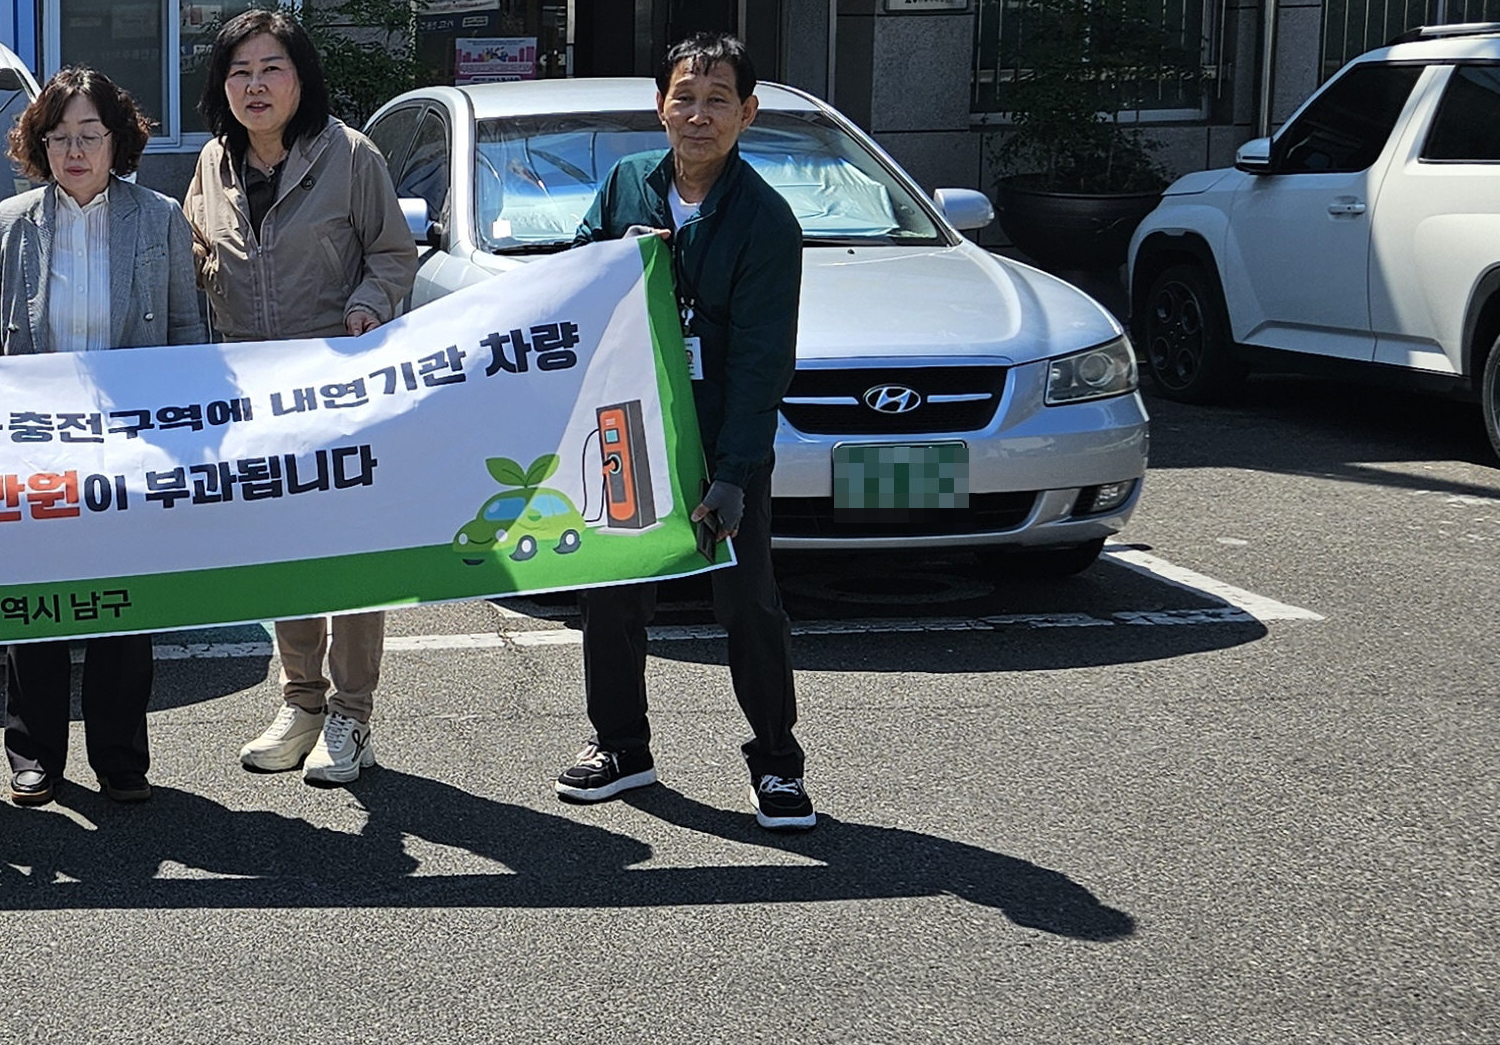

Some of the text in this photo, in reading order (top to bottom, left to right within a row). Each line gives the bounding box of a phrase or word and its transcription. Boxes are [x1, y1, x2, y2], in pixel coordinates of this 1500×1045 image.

[269, 344, 467, 417] 내연기관
[480, 321, 580, 378] 차량
[145, 444, 378, 509] 부과됩니다
[70, 589, 132, 621] 남구
